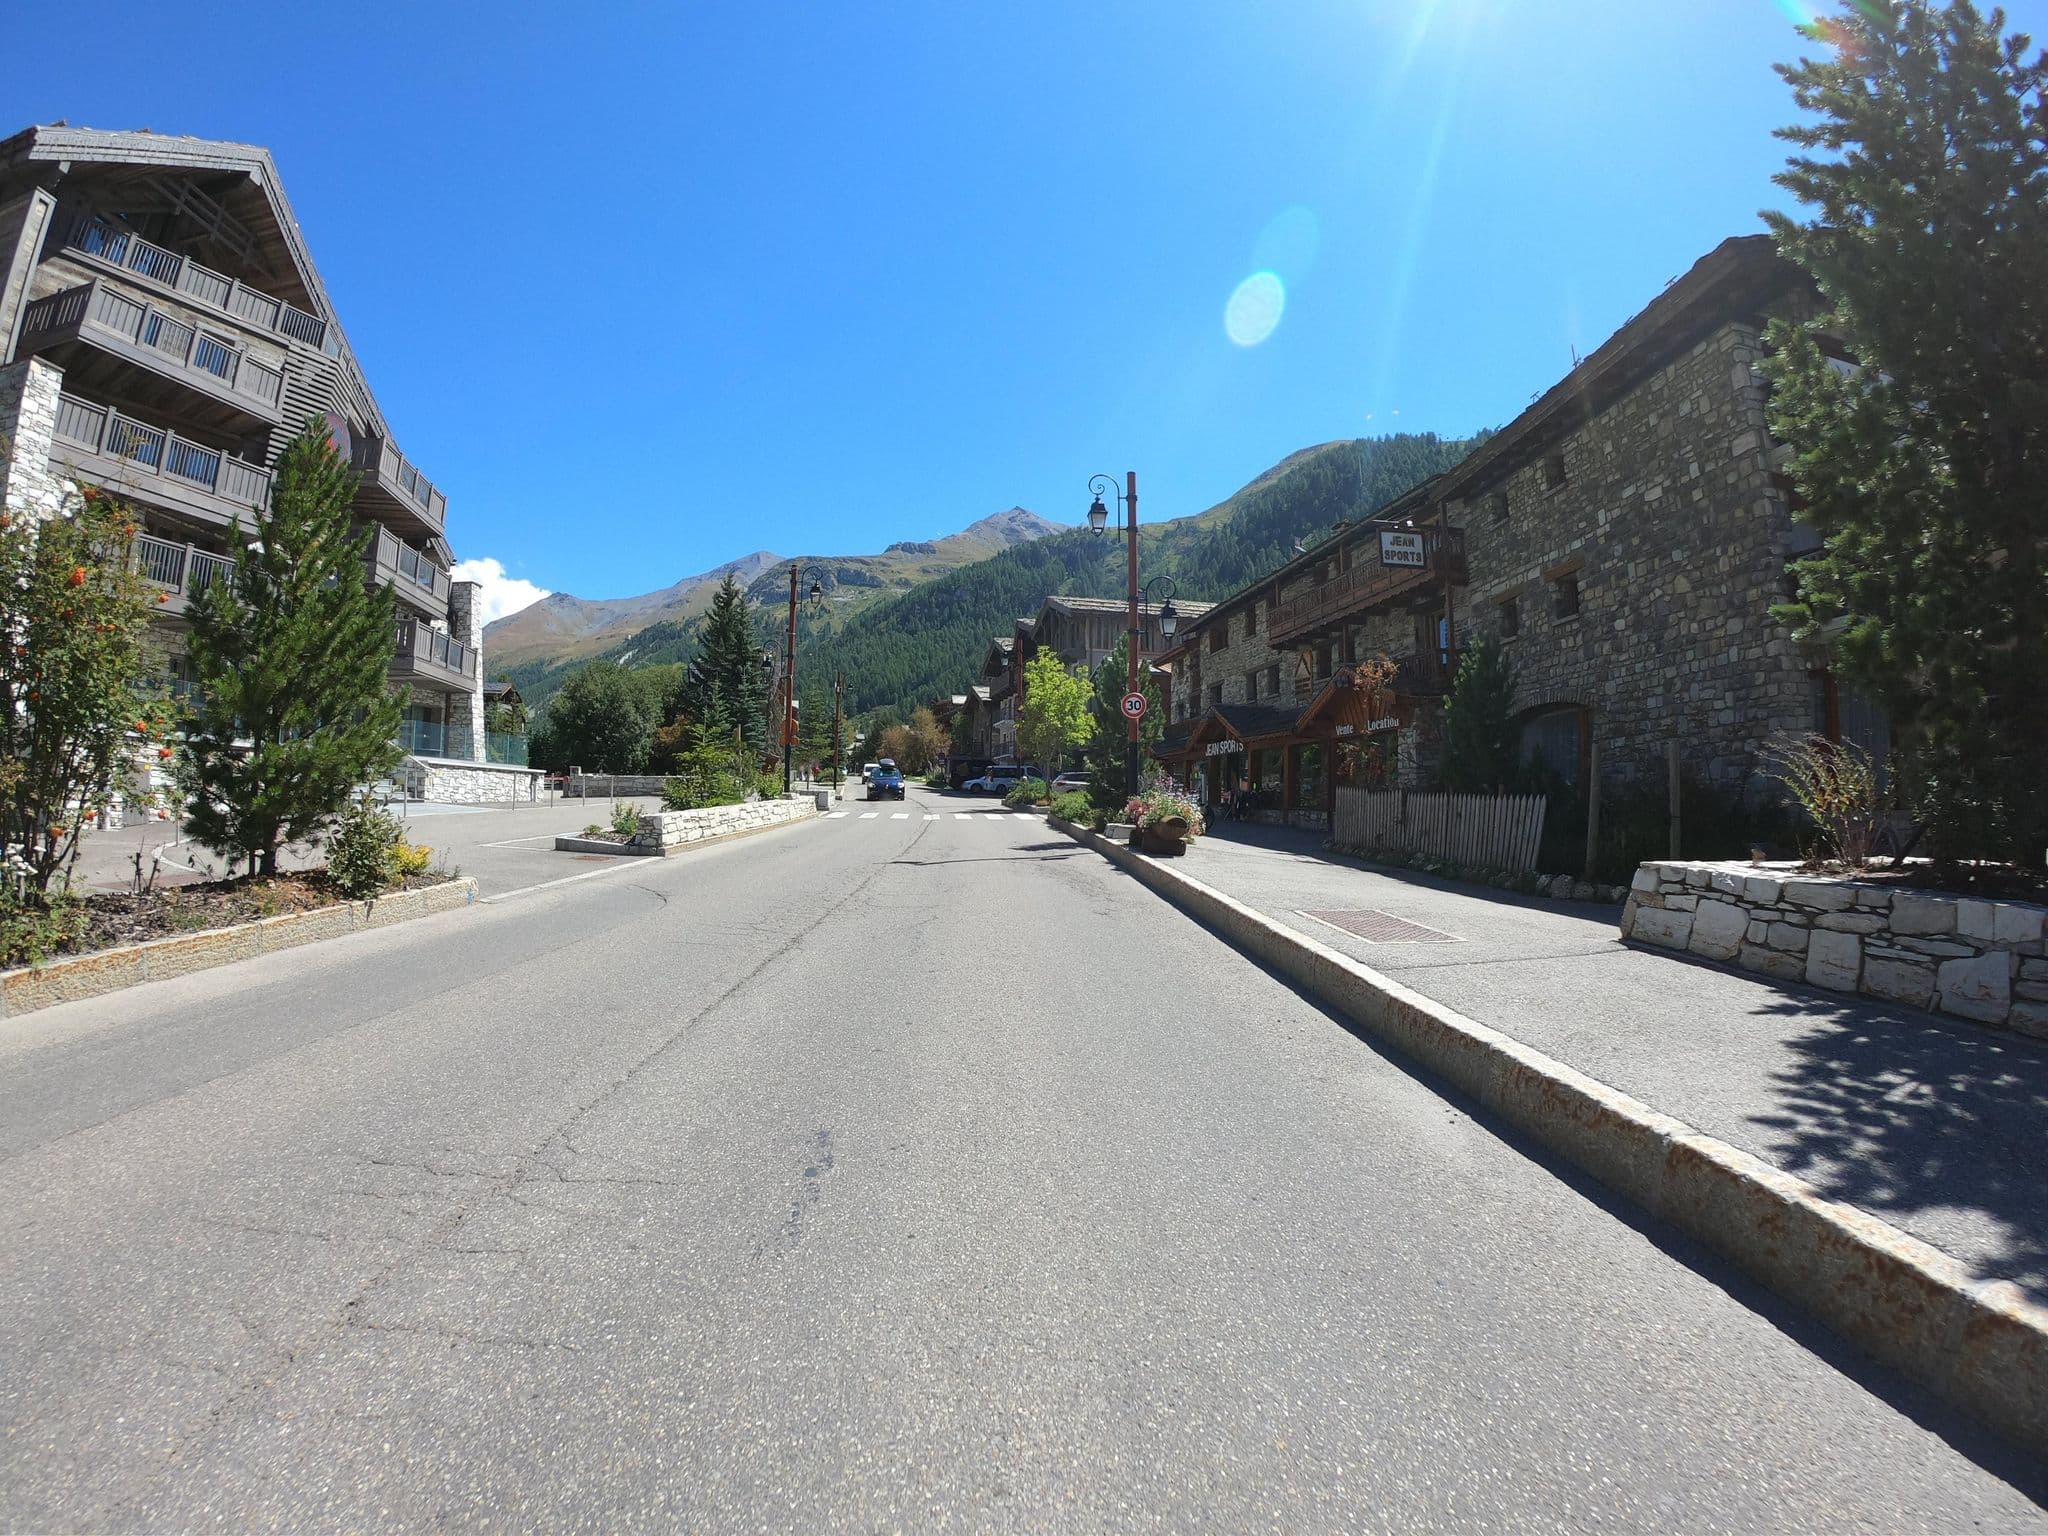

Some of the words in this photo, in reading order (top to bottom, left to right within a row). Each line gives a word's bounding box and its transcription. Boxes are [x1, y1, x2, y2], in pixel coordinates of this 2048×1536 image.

[1390, 535, 1415, 547] JEAN
[1384, 550, 1421, 562] SPORTS
[1127, 700, 1141, 711] 30
[1367, 715, 1399, 731] Location
[1205, 742, 1219, 757] JEAN
[1219, 739, 1244, 754] SPORTS
